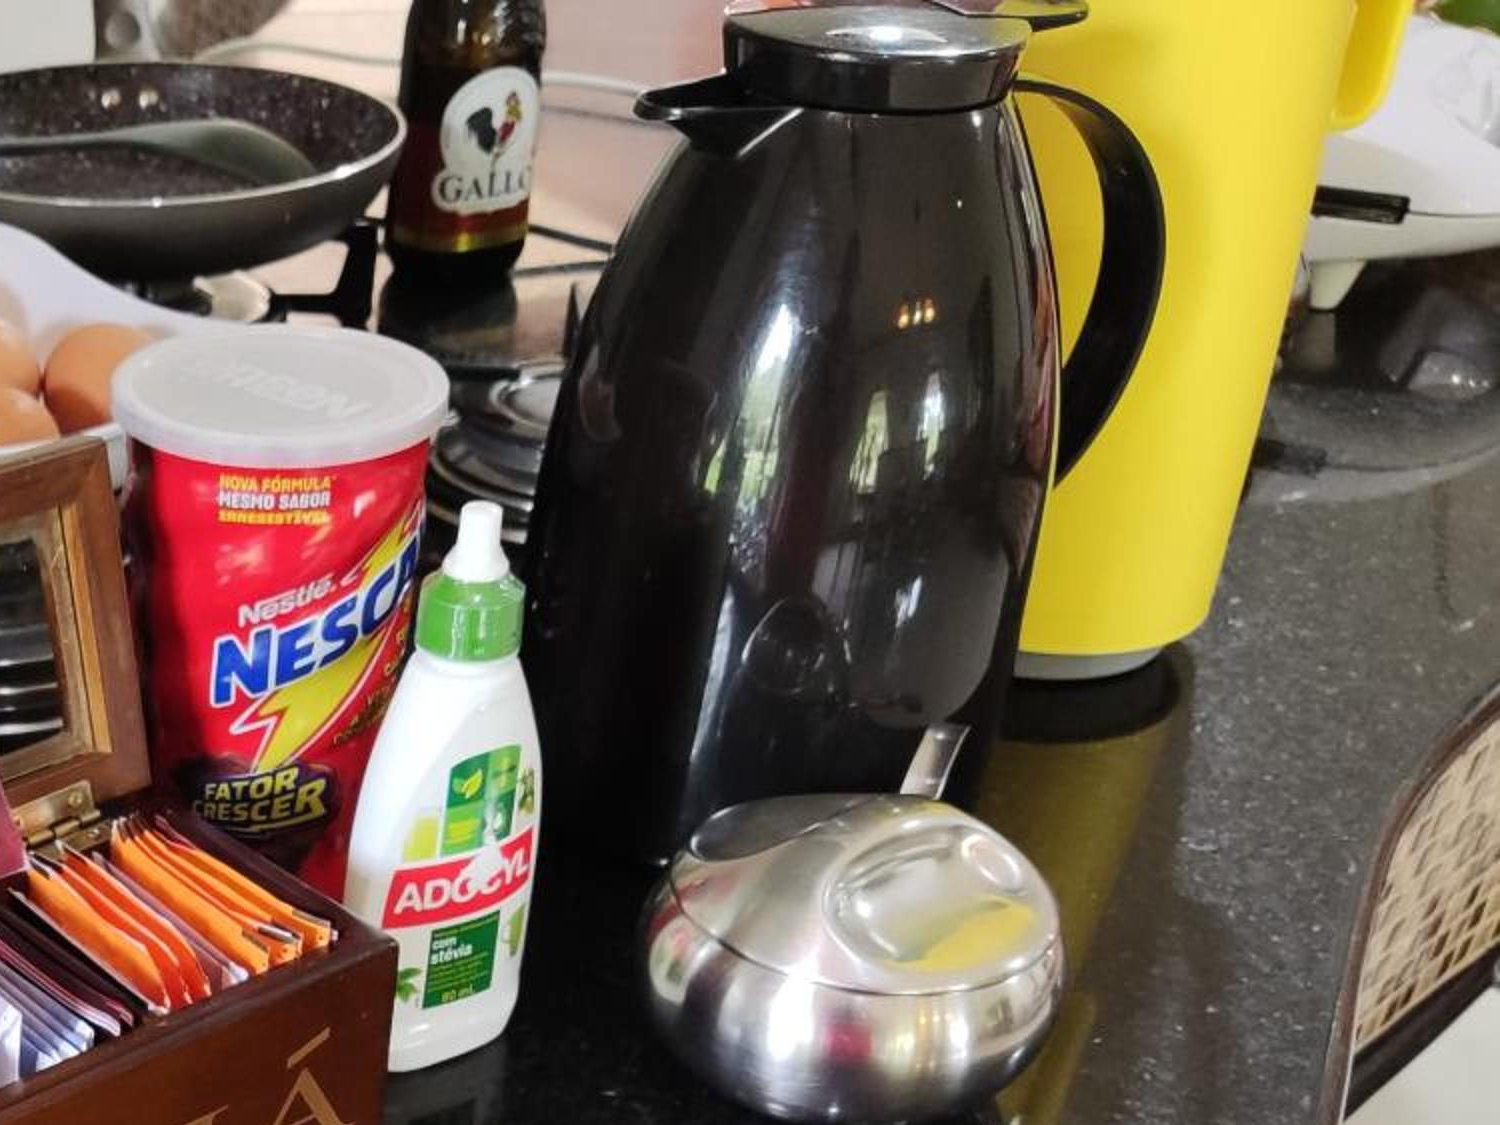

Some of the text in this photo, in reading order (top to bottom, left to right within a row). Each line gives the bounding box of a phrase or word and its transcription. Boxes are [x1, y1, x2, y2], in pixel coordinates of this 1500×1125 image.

[219, 474, 257, 490] NOVA
[218, 490, 331, 509] MESMO SABOR
[204, 764, 299, 802] FATOR
[193, 778, 327, 822] CRESCER
